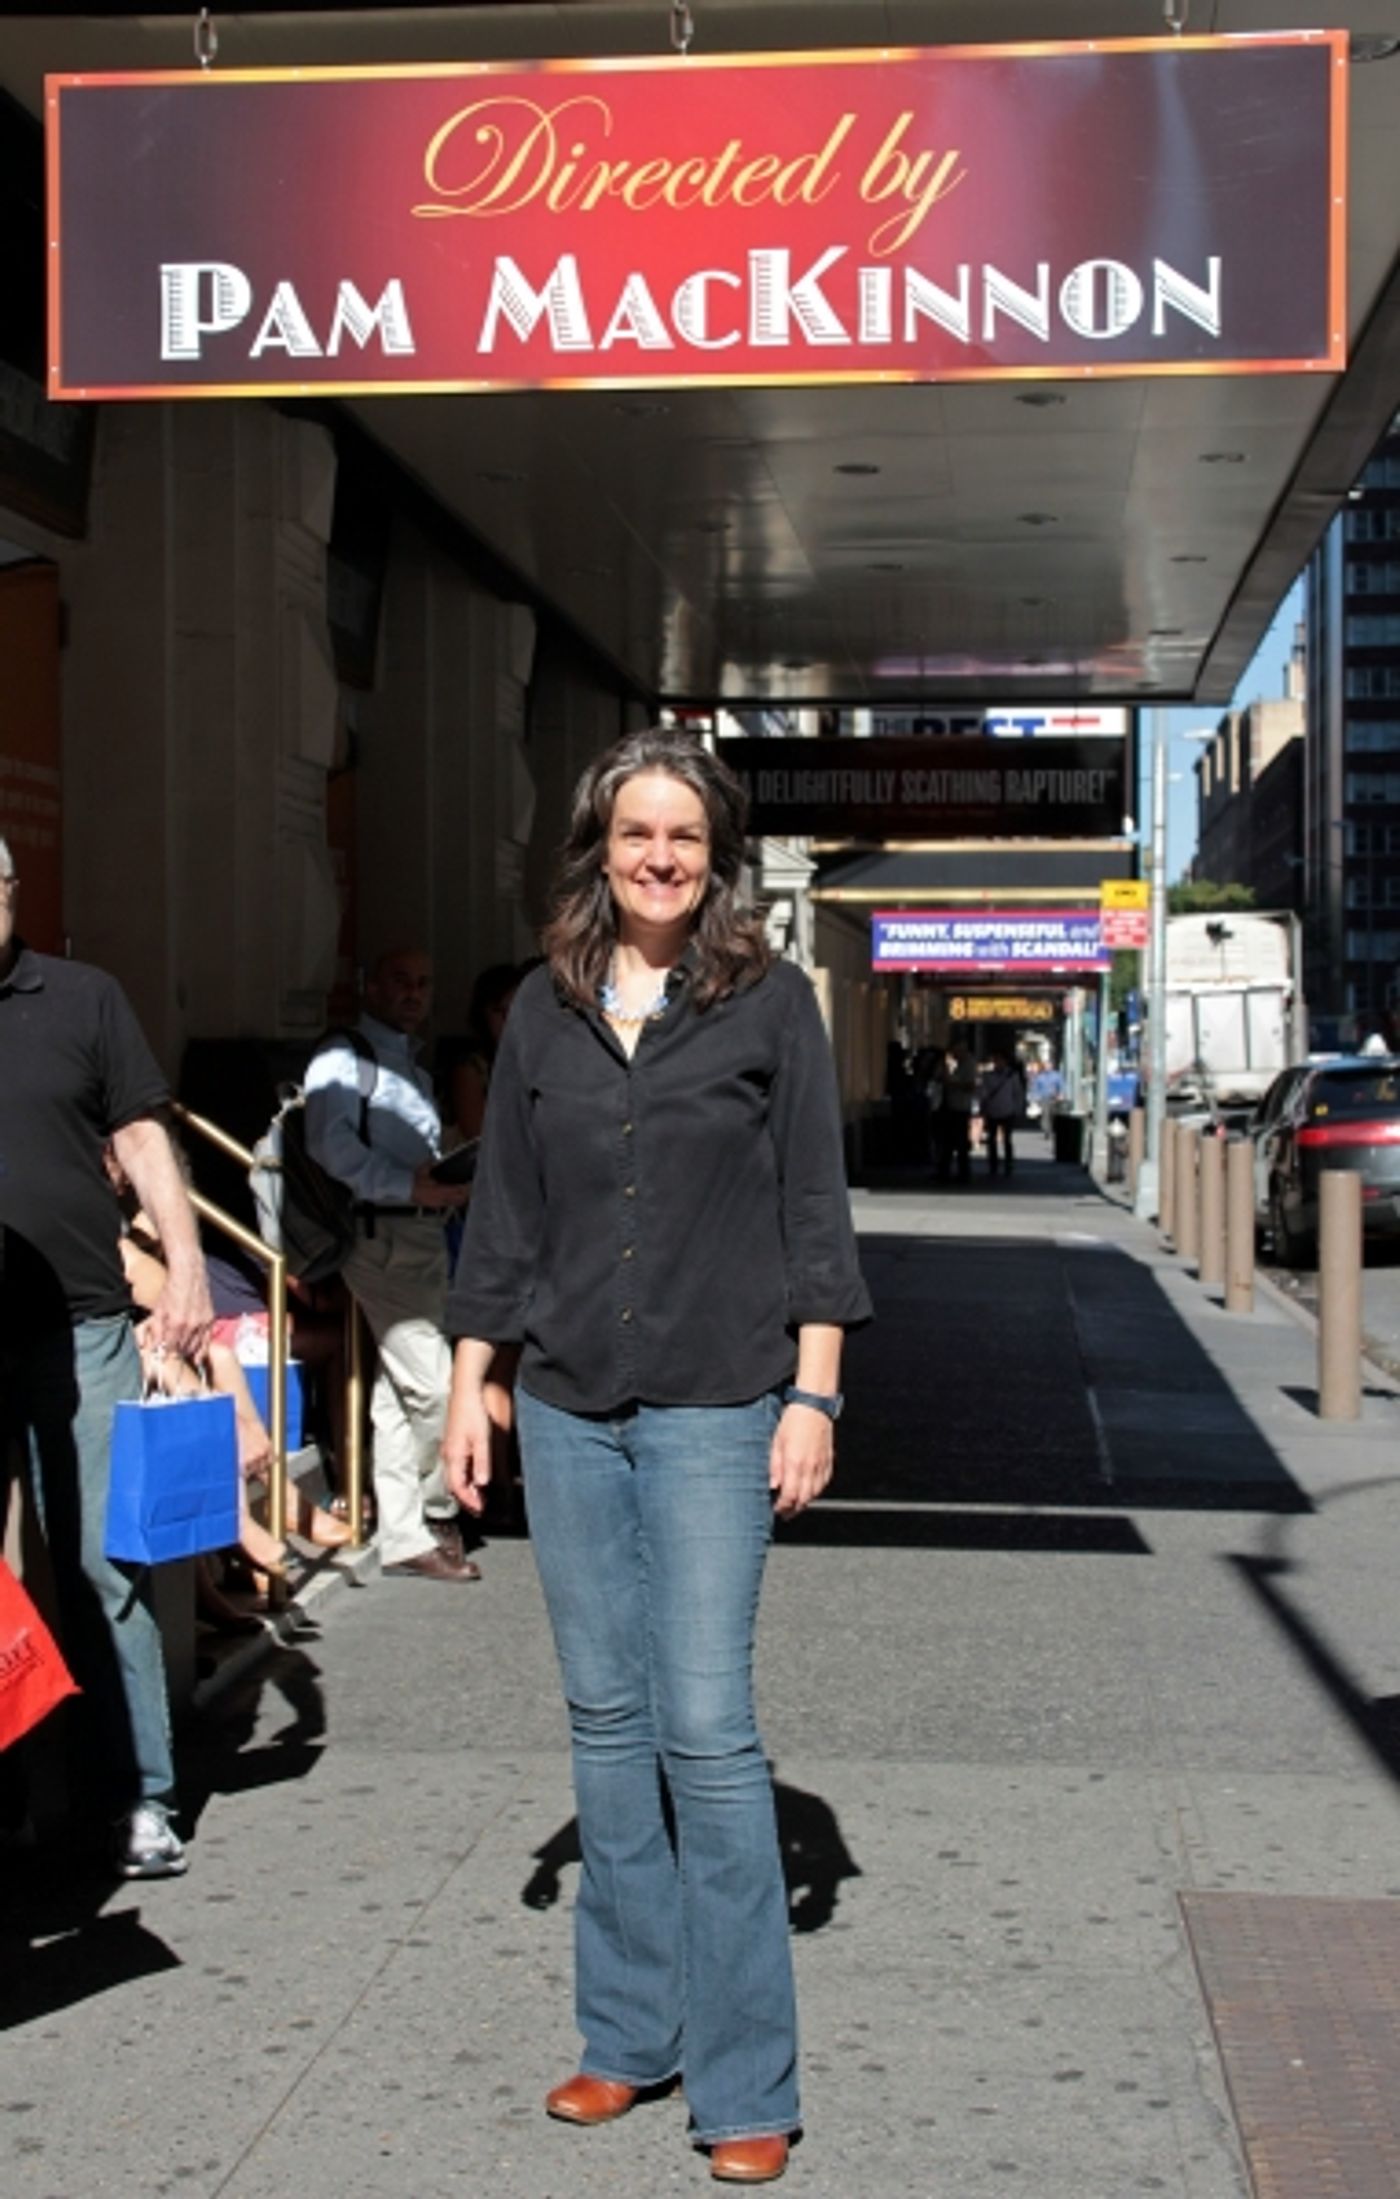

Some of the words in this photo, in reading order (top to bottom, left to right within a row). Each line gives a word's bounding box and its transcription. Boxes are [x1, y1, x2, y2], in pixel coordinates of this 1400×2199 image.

[410, 95, 857, 218] Directed
[858, 111, 968, 257] by
[757, 769, 894, 805] DELIGHTFULLY
[901, 769, 1002, 805] SCATHING
